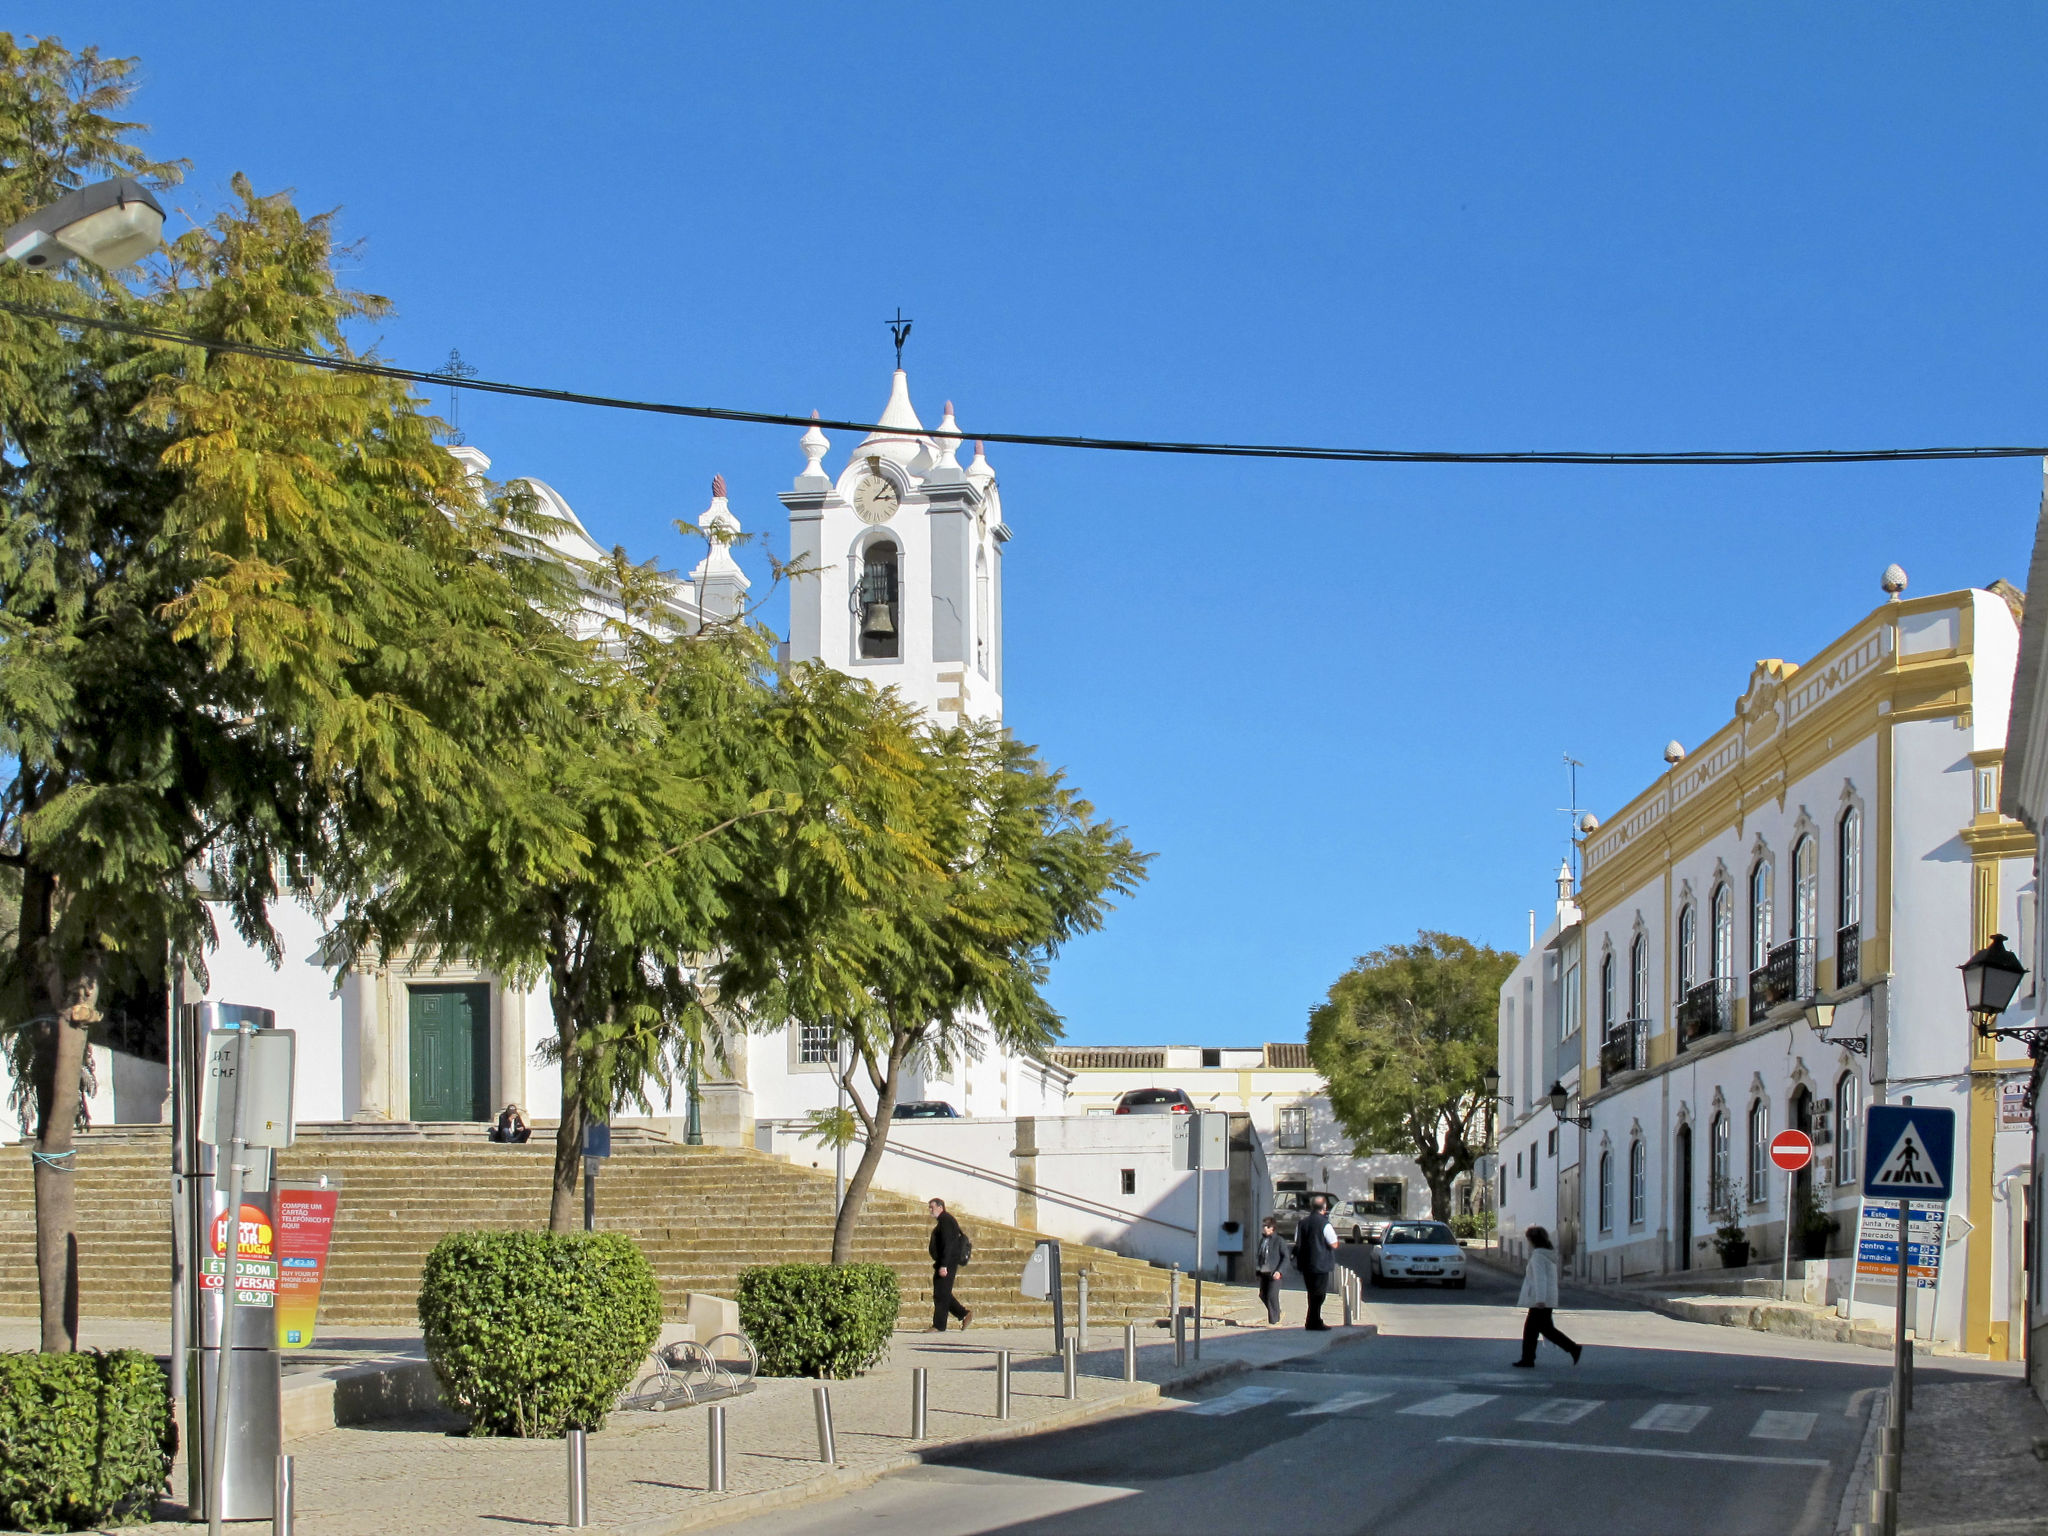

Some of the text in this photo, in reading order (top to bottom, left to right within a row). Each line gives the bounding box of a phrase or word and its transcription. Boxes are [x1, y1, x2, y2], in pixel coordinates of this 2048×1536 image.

[1862, 1220, 1920, 1230] junta fregsia
[1861, 1231, 1893, 1239] mercado
[1860, 1242, 1885, 1250] centro
[1859, 1253, 1892, 1262] farmácia
[211, 1260, 219, 1273] É
[245, 1263, 271, 1276] BOM
[205, 1275, 276, 1290] COVERSAR
